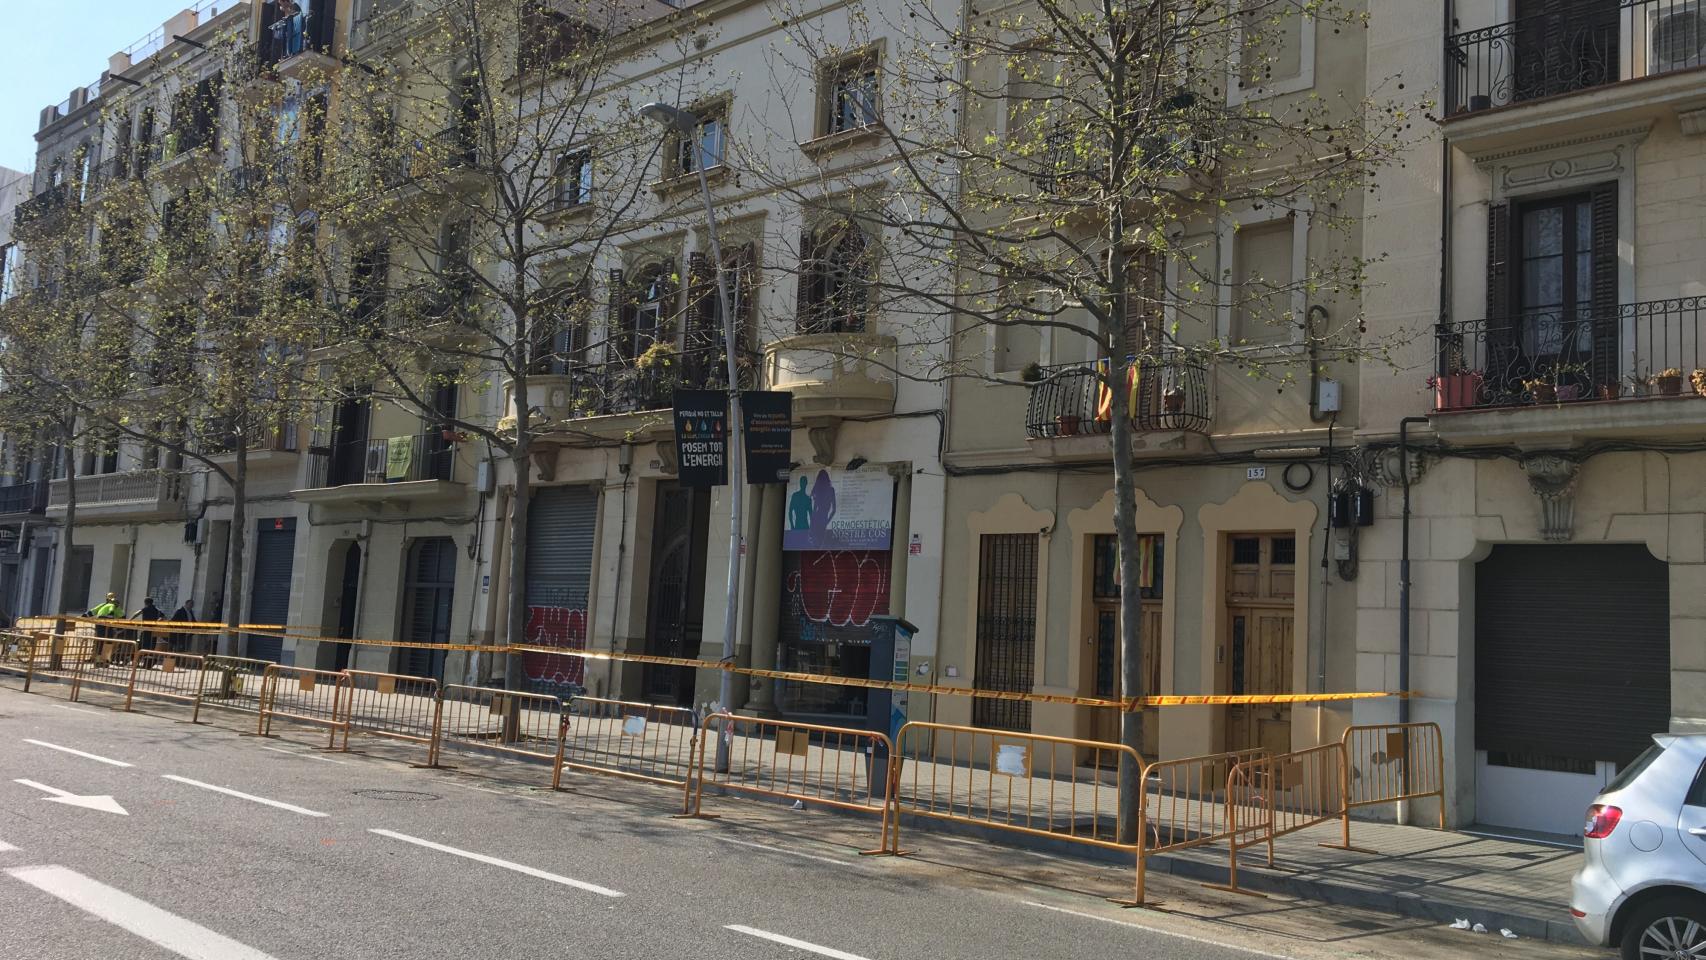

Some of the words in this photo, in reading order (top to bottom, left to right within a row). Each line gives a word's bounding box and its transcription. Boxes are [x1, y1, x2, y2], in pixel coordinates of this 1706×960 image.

[682, 442, 707, 453] POSEM
[1248, 469, 1264, 478] 157
[868, 528, 887, 538] COS
